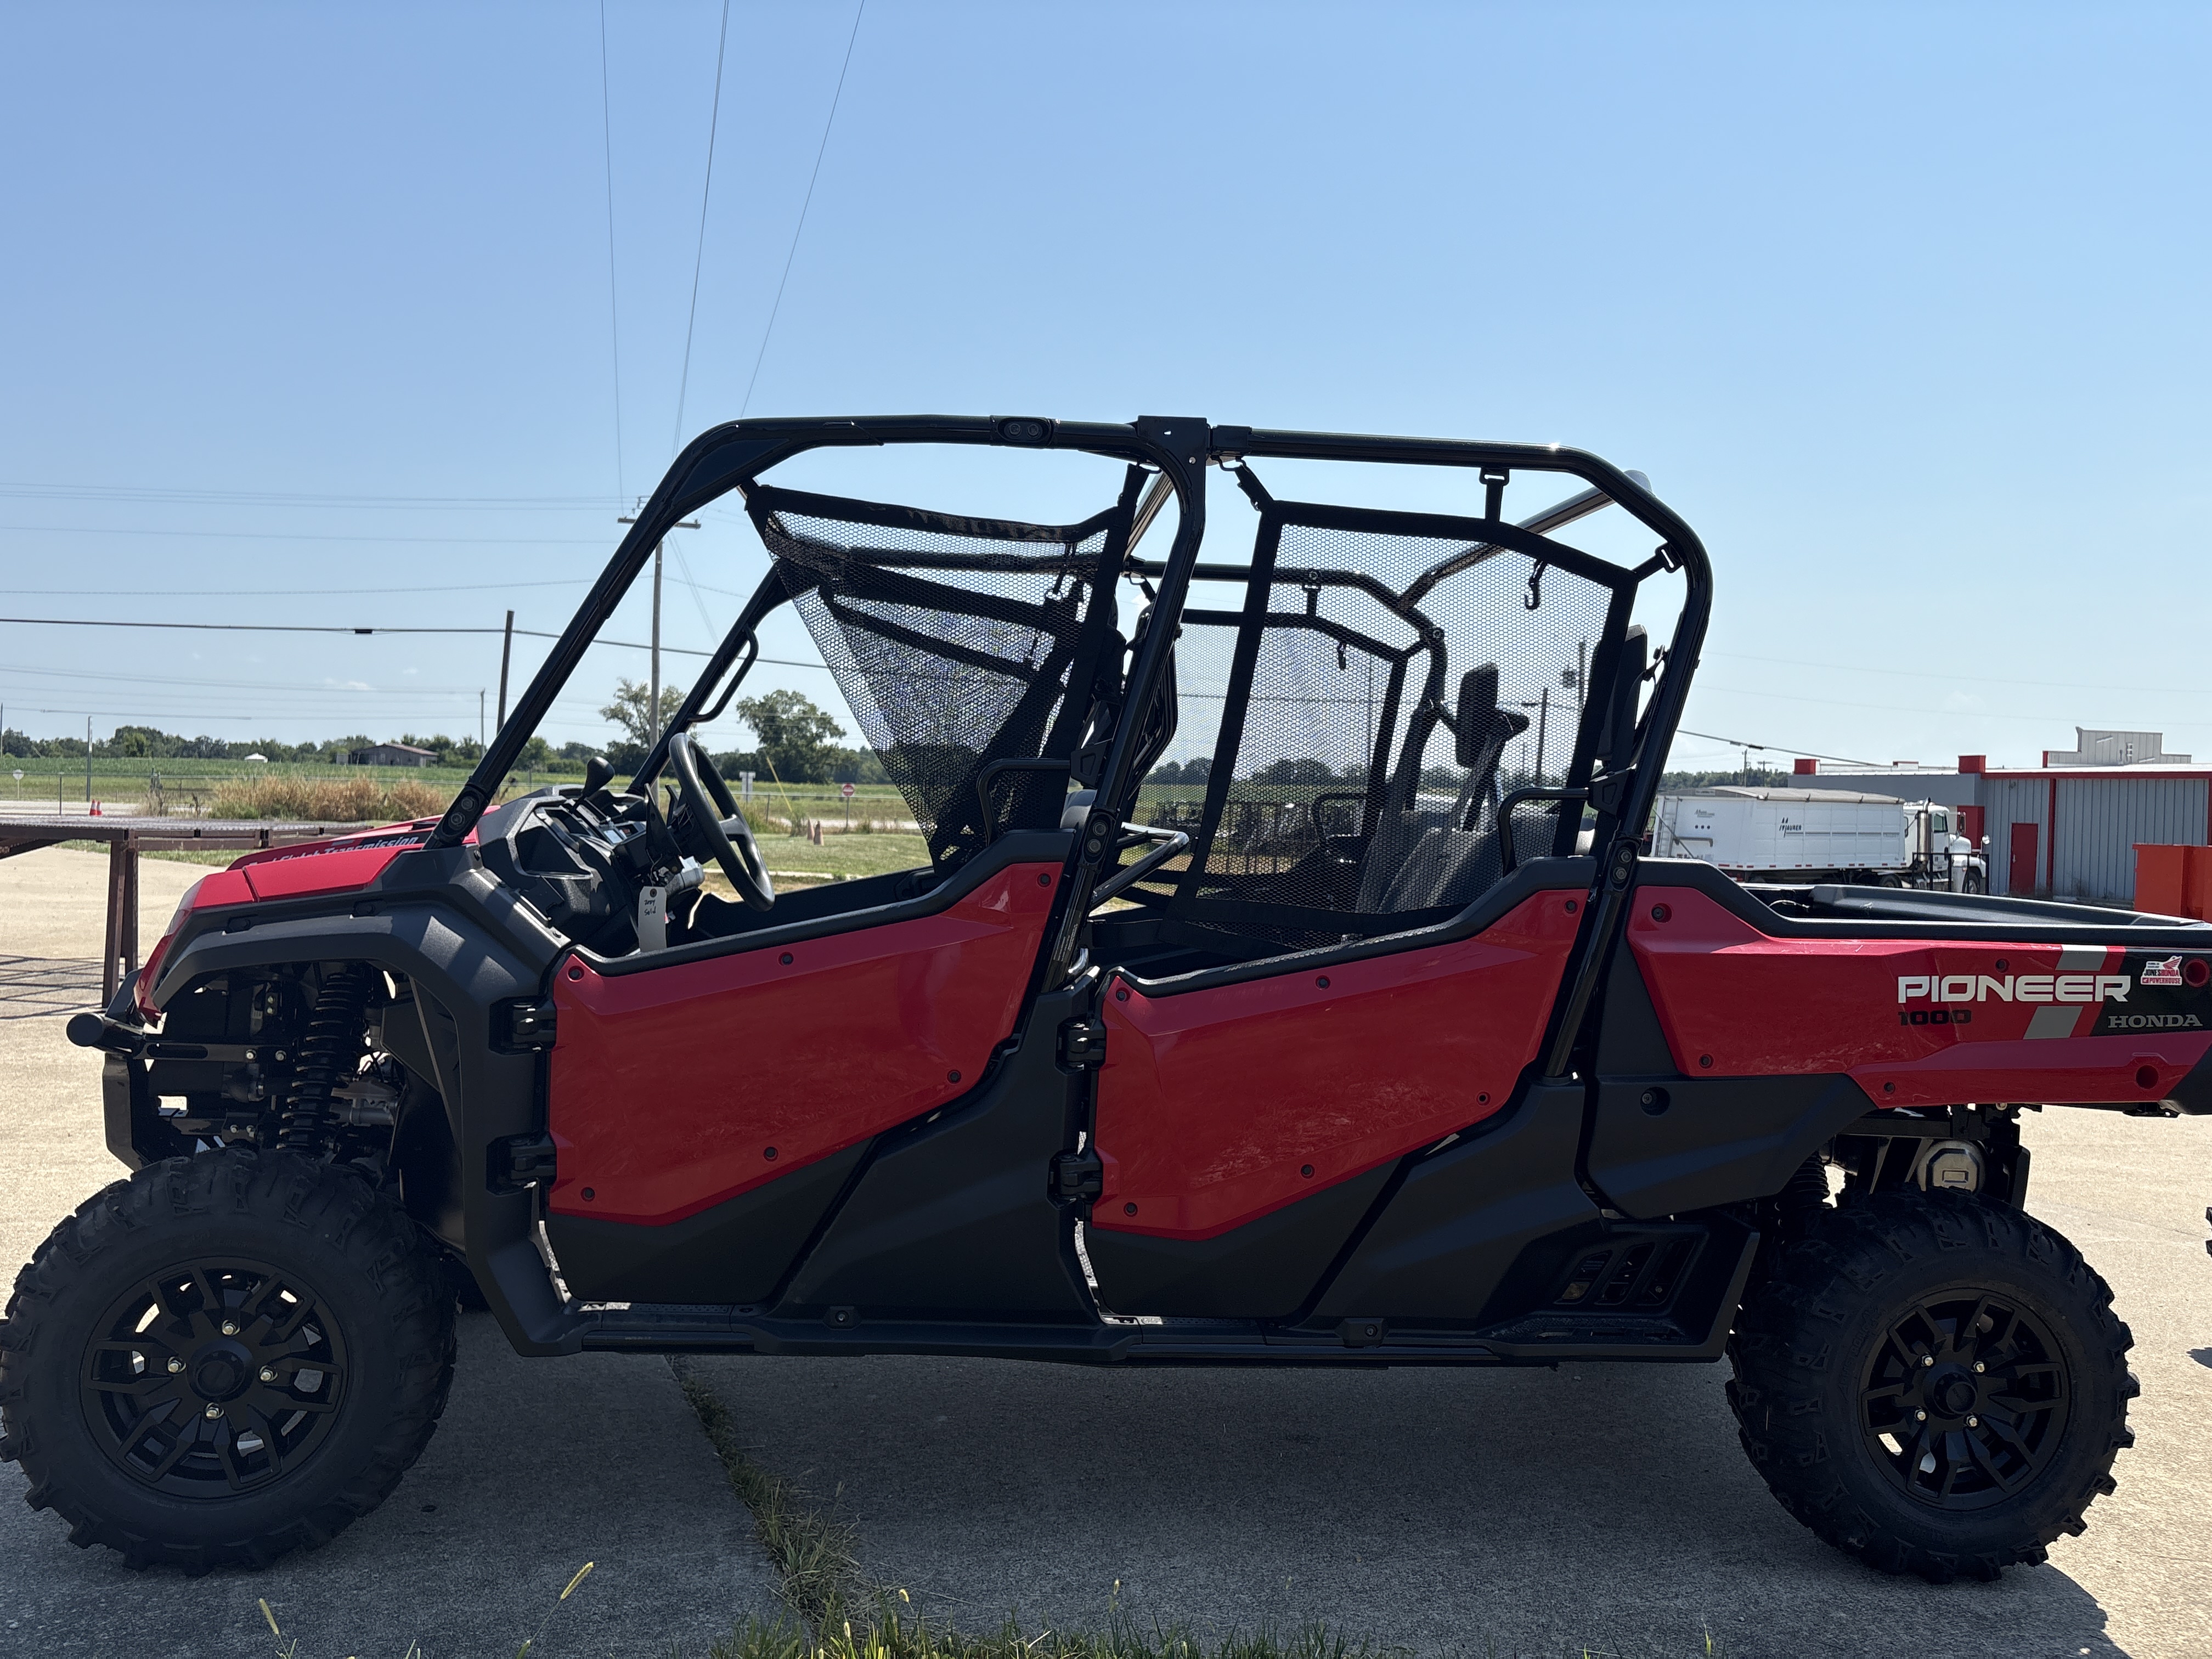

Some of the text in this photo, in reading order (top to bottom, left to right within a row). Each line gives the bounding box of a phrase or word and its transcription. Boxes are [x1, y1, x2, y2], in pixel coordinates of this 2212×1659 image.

[1897, 975, 2131, 1003] PIONEER
[1898, 1009, 1972, 1026] 1000
[2108, 1014, 2203, 1029] HONDA
